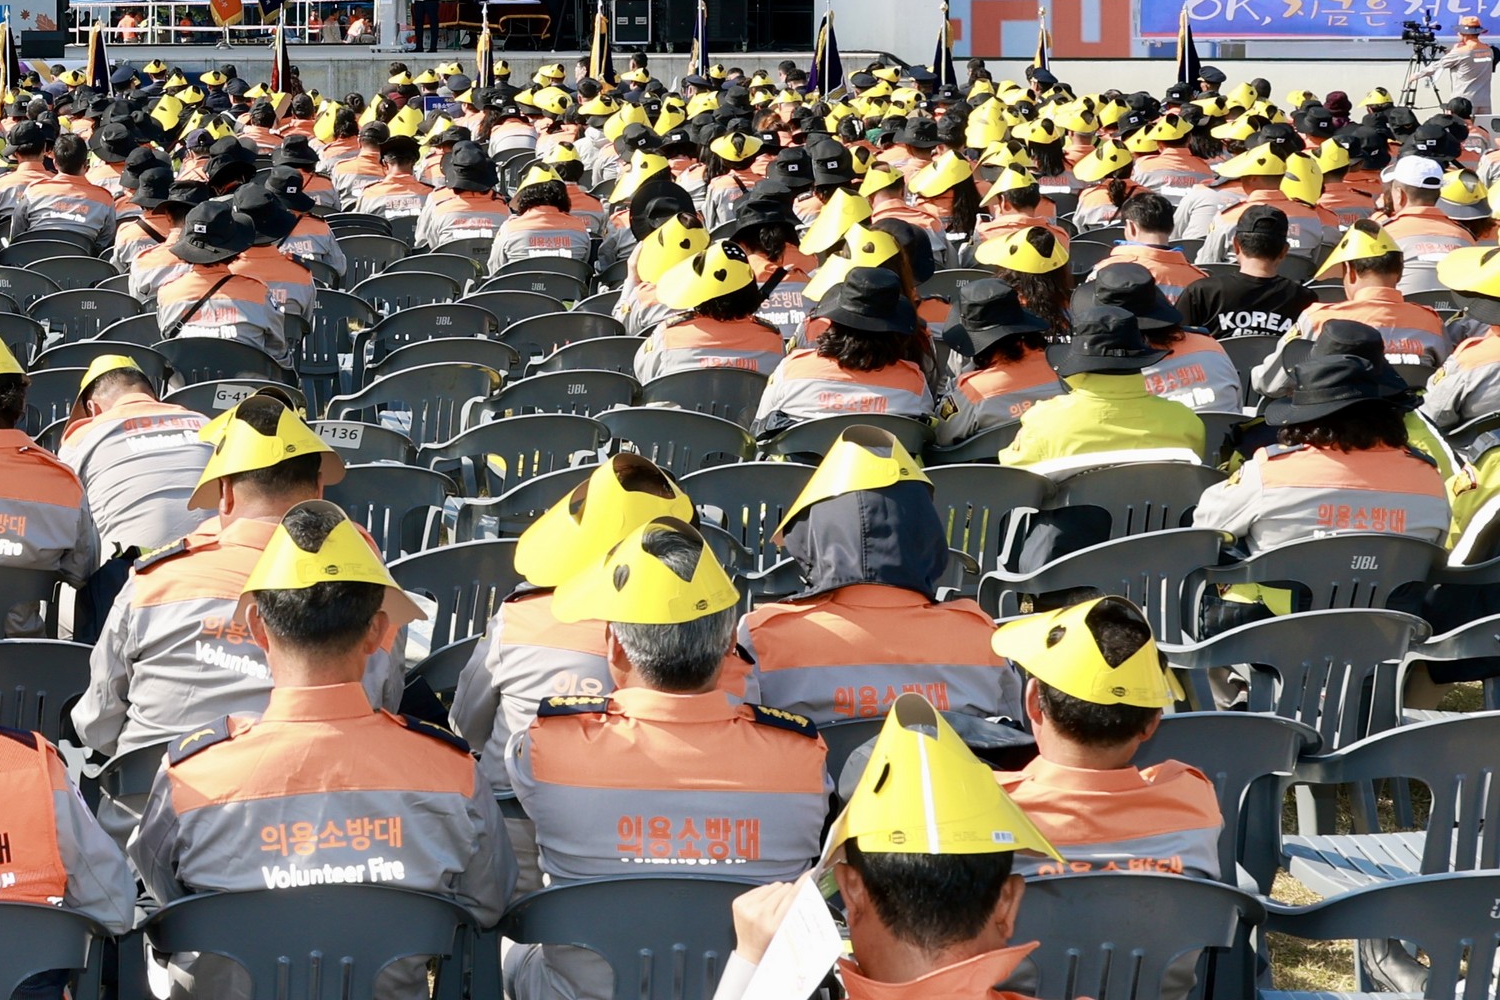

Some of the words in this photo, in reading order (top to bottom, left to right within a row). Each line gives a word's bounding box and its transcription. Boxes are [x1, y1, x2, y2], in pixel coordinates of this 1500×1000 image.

[81, 300, 97, 310] JBL
[436, 316, 453, 326] JBL
[1219, 310, 1293, 334] KOREA
[567, 384, 587, 395] JBL
[319, 427, 359, 441] I-136
[1316, 503, 1407, 534] 의용소방대
[1351, 556, 1379, 570] JBL
[260, 816, 403, 857] 의용소방대
[617, 815, 761, 861] 의용소방대
[261, 862, 364, 891] Volunteer
[367, 856, 405, 882] Fire
